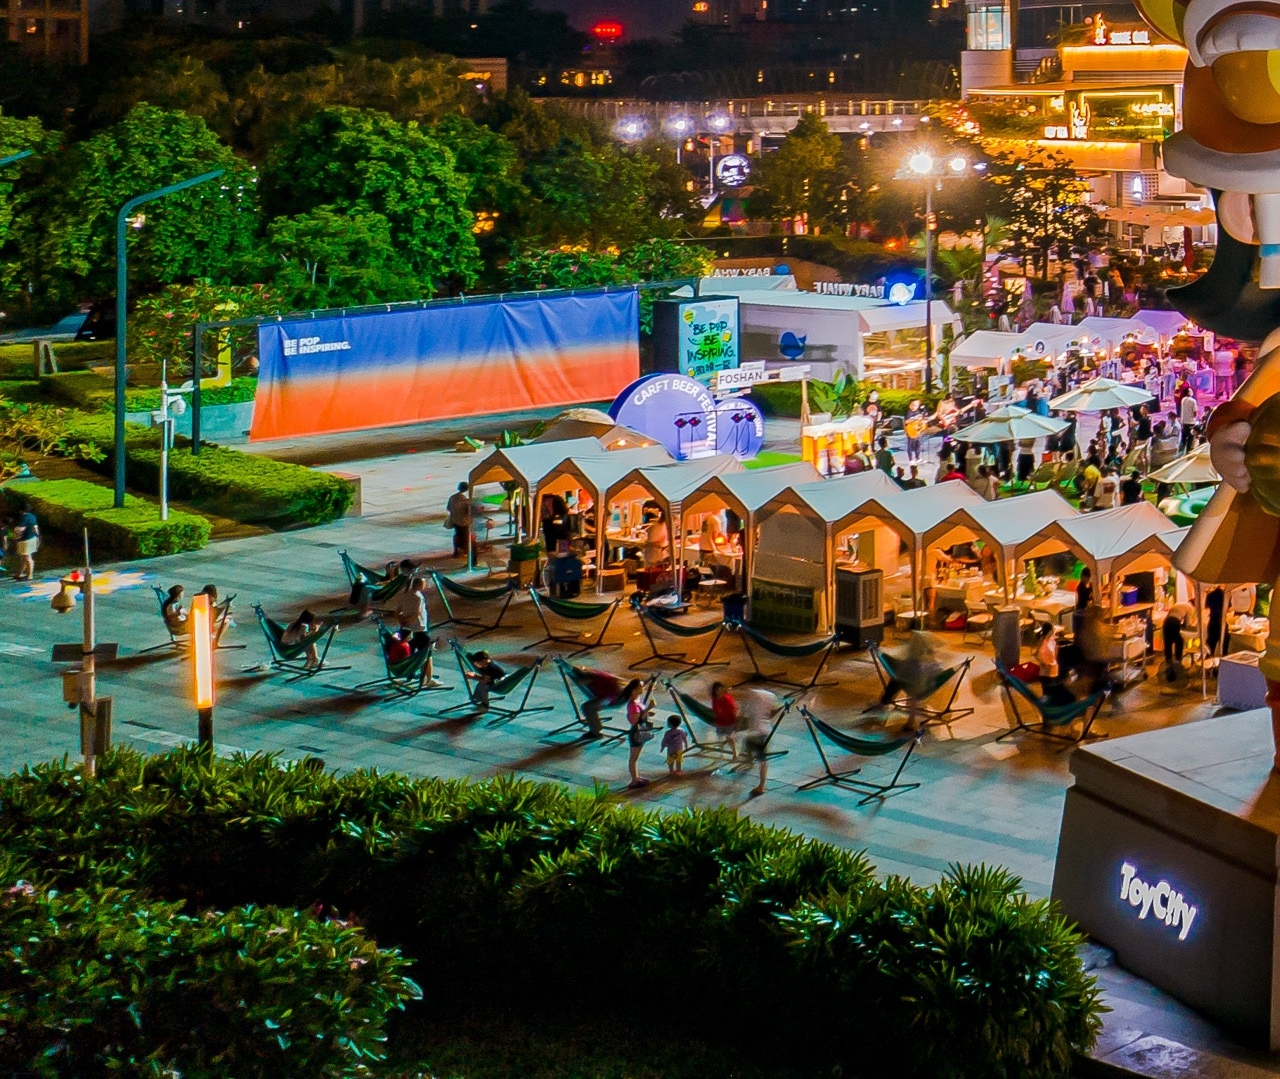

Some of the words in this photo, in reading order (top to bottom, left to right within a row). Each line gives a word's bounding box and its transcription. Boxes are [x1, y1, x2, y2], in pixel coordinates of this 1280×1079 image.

[284, 339, 297, 348] BE
[299, 337, 320, 346] POP
[703, 333, 719, 345] BE
[284, 347, 297, 356] BE
[299, 341, 351, 354] INSPIRING.
[719, 371, 763, 385] FOSHAN
[634, 379, 670, 406] CARFT
[672, 379, 700, 397] BEER
[696, 392, 717, 448] FESTIVAL
[1120, 861, 1197, 941] ToyCity
